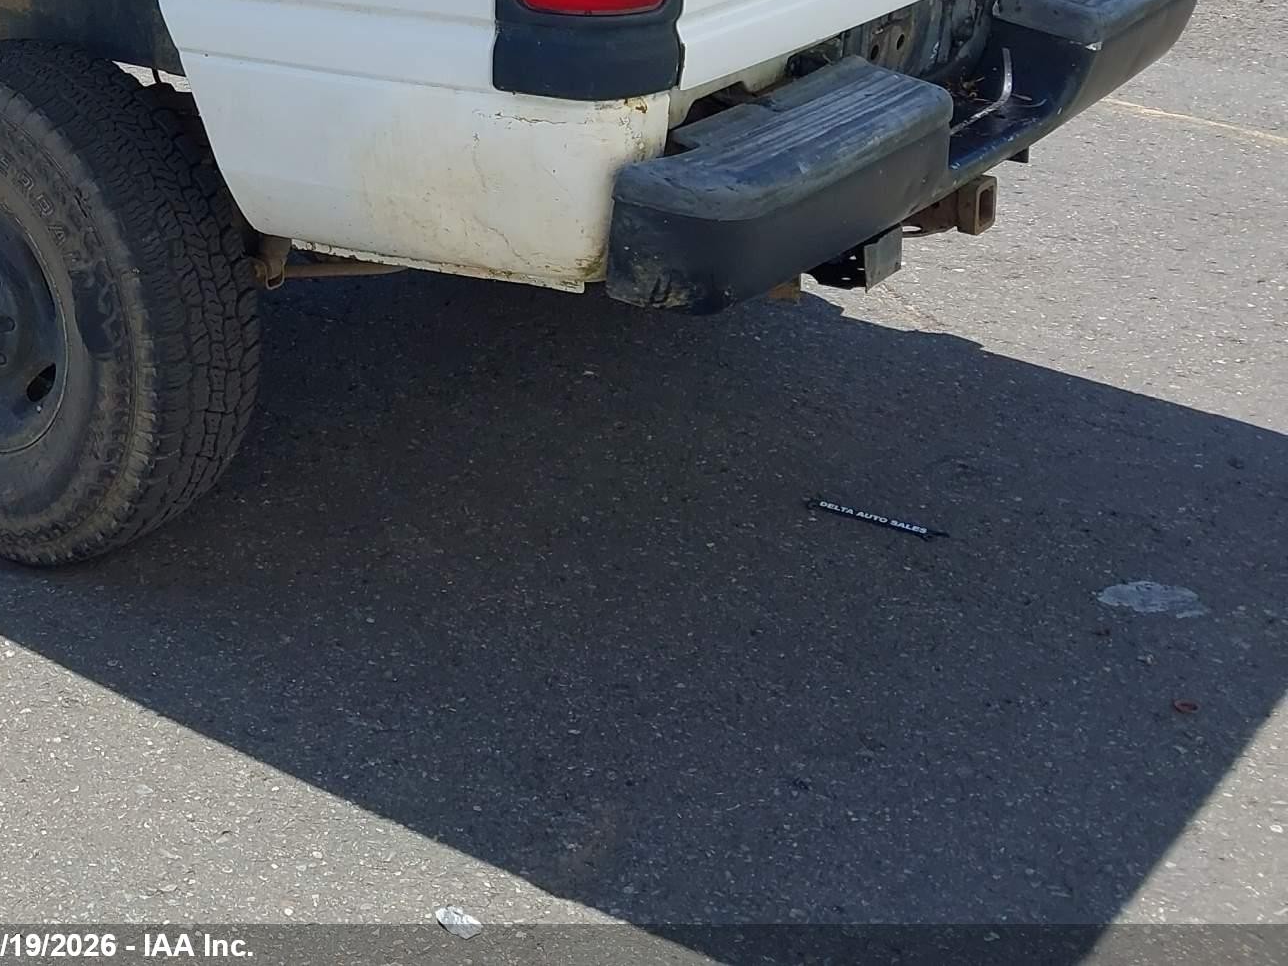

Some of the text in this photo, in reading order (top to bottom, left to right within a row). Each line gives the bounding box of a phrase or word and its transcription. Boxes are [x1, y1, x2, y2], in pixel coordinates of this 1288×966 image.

[819, 500, 928, 535] DELTA AUTO SALES
